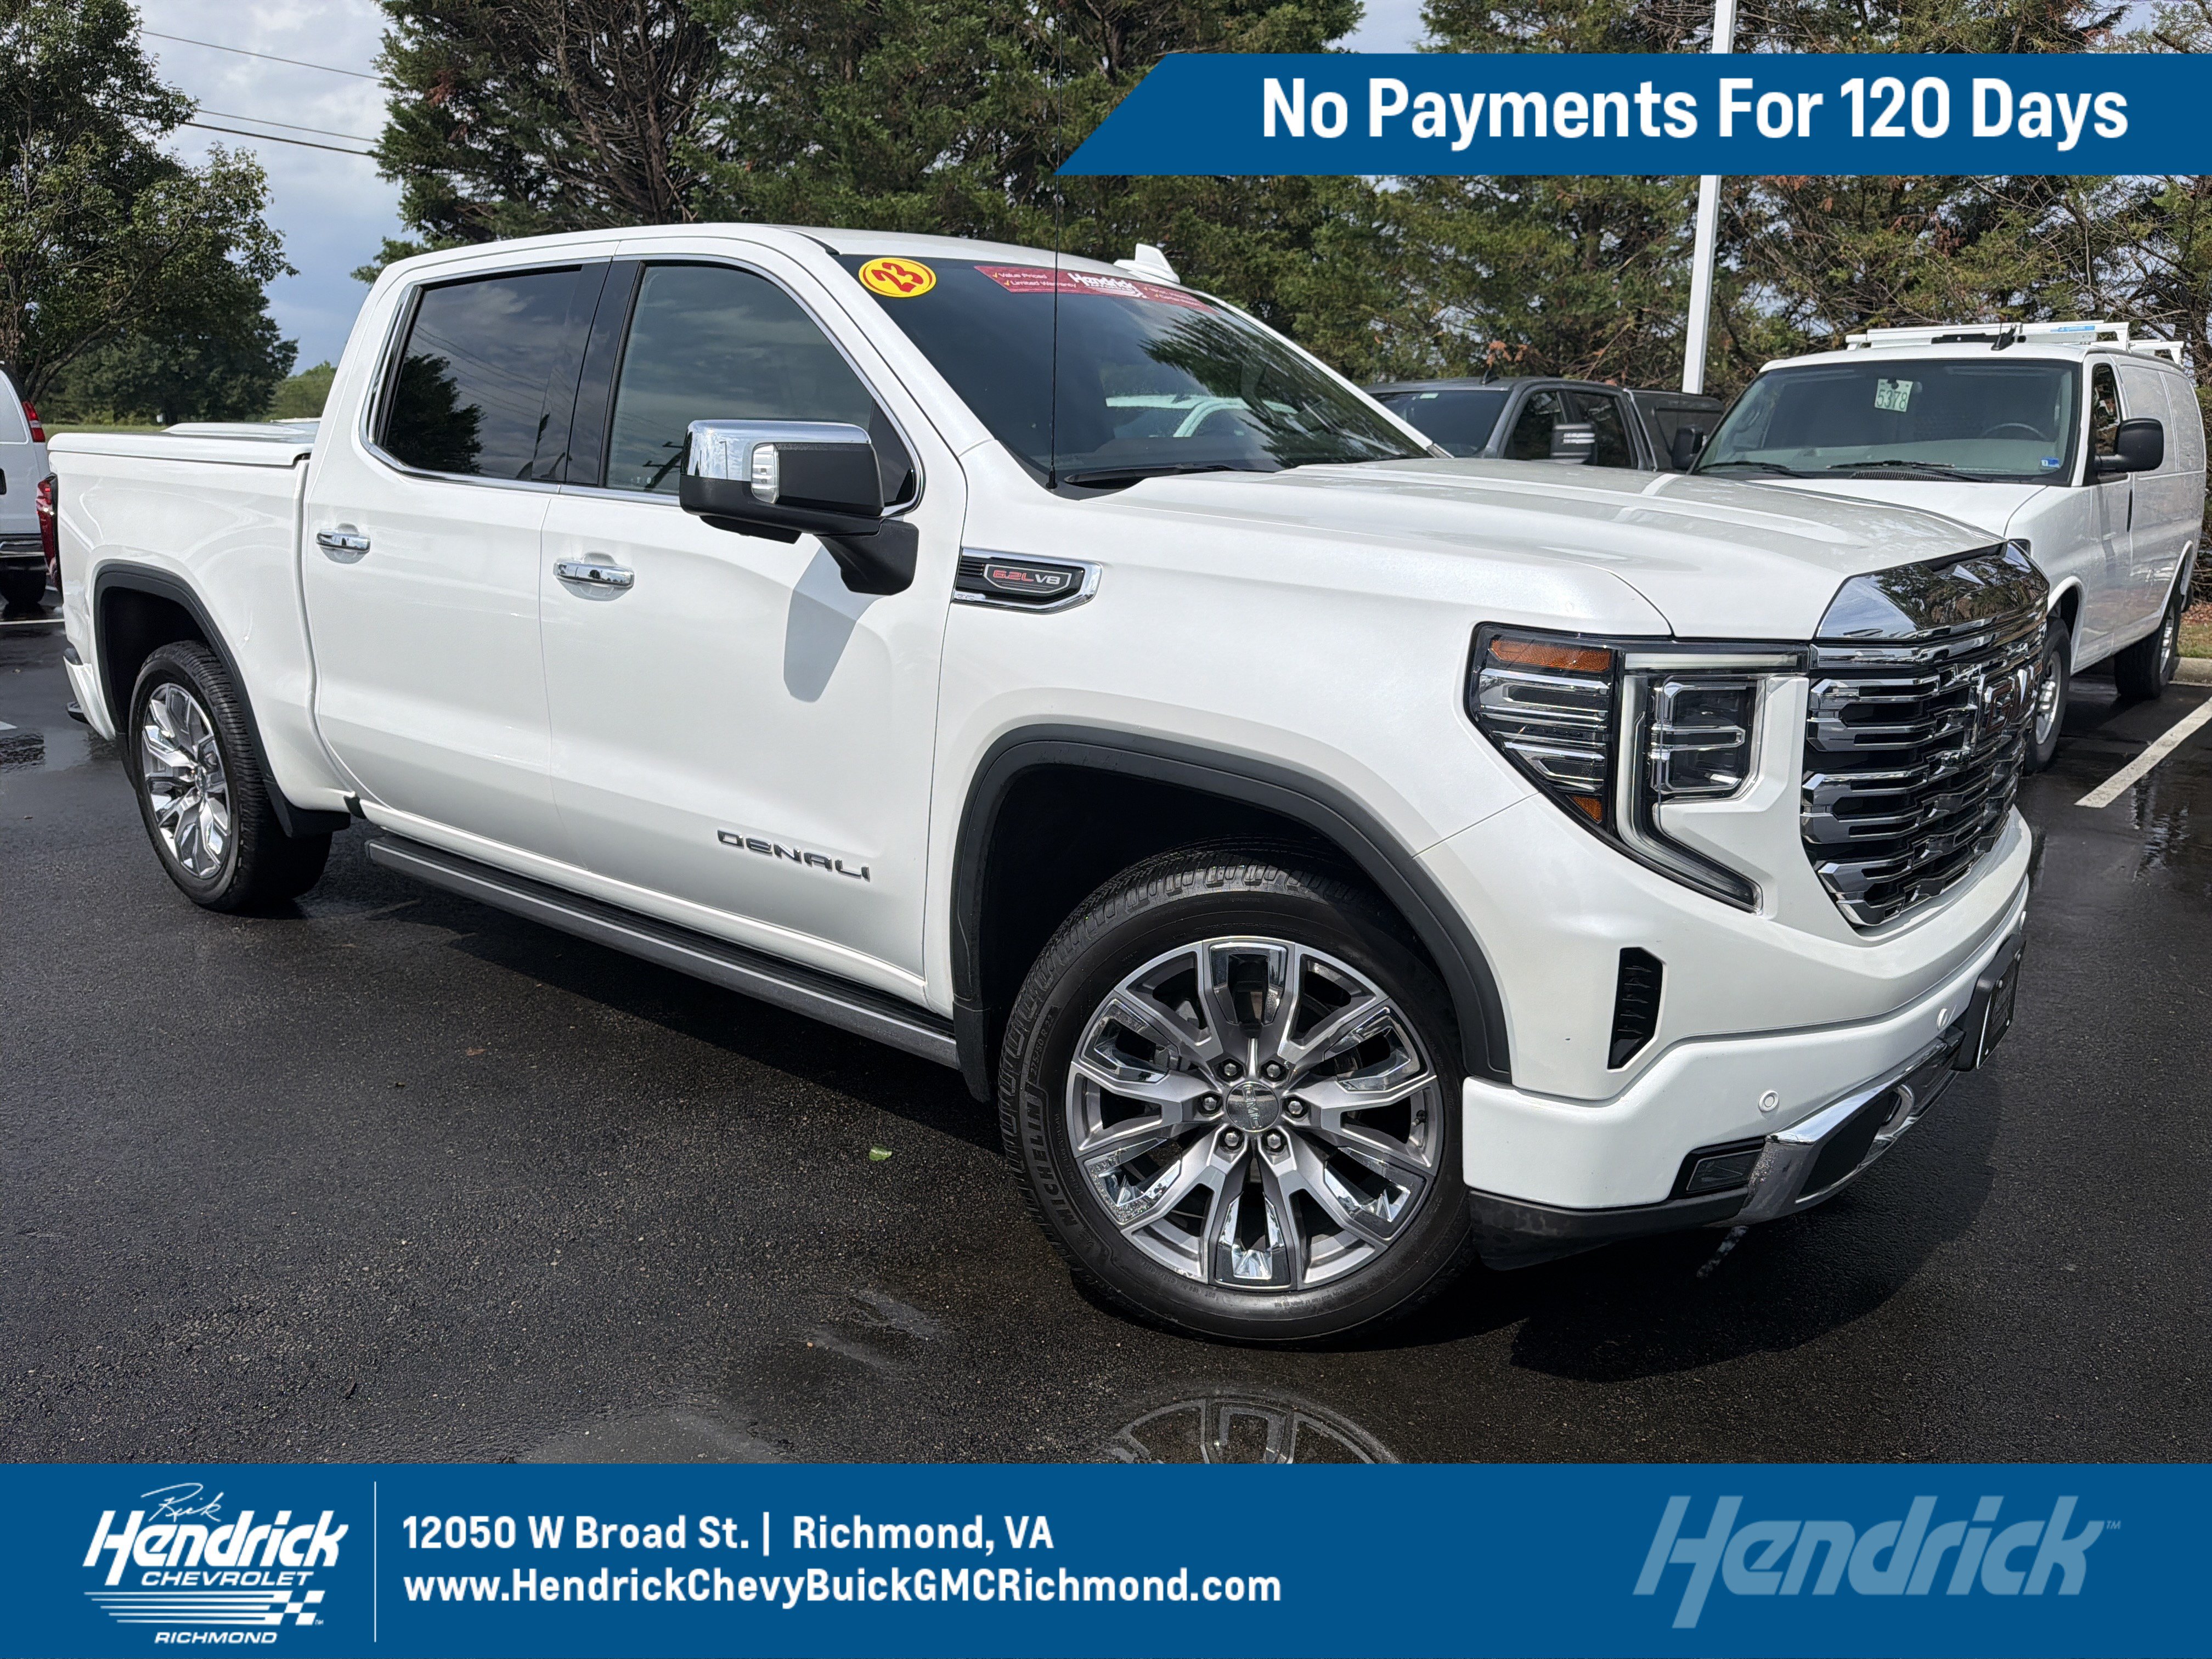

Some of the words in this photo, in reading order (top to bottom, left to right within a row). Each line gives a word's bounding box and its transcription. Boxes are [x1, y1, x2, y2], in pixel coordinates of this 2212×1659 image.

[871, 262, 924, 292] 23
[1876, 389, 1908, 410] 5378
[716, 827, 871, 883] DENALI
[1027, 1101, 1078, 1227] MICHELIN
